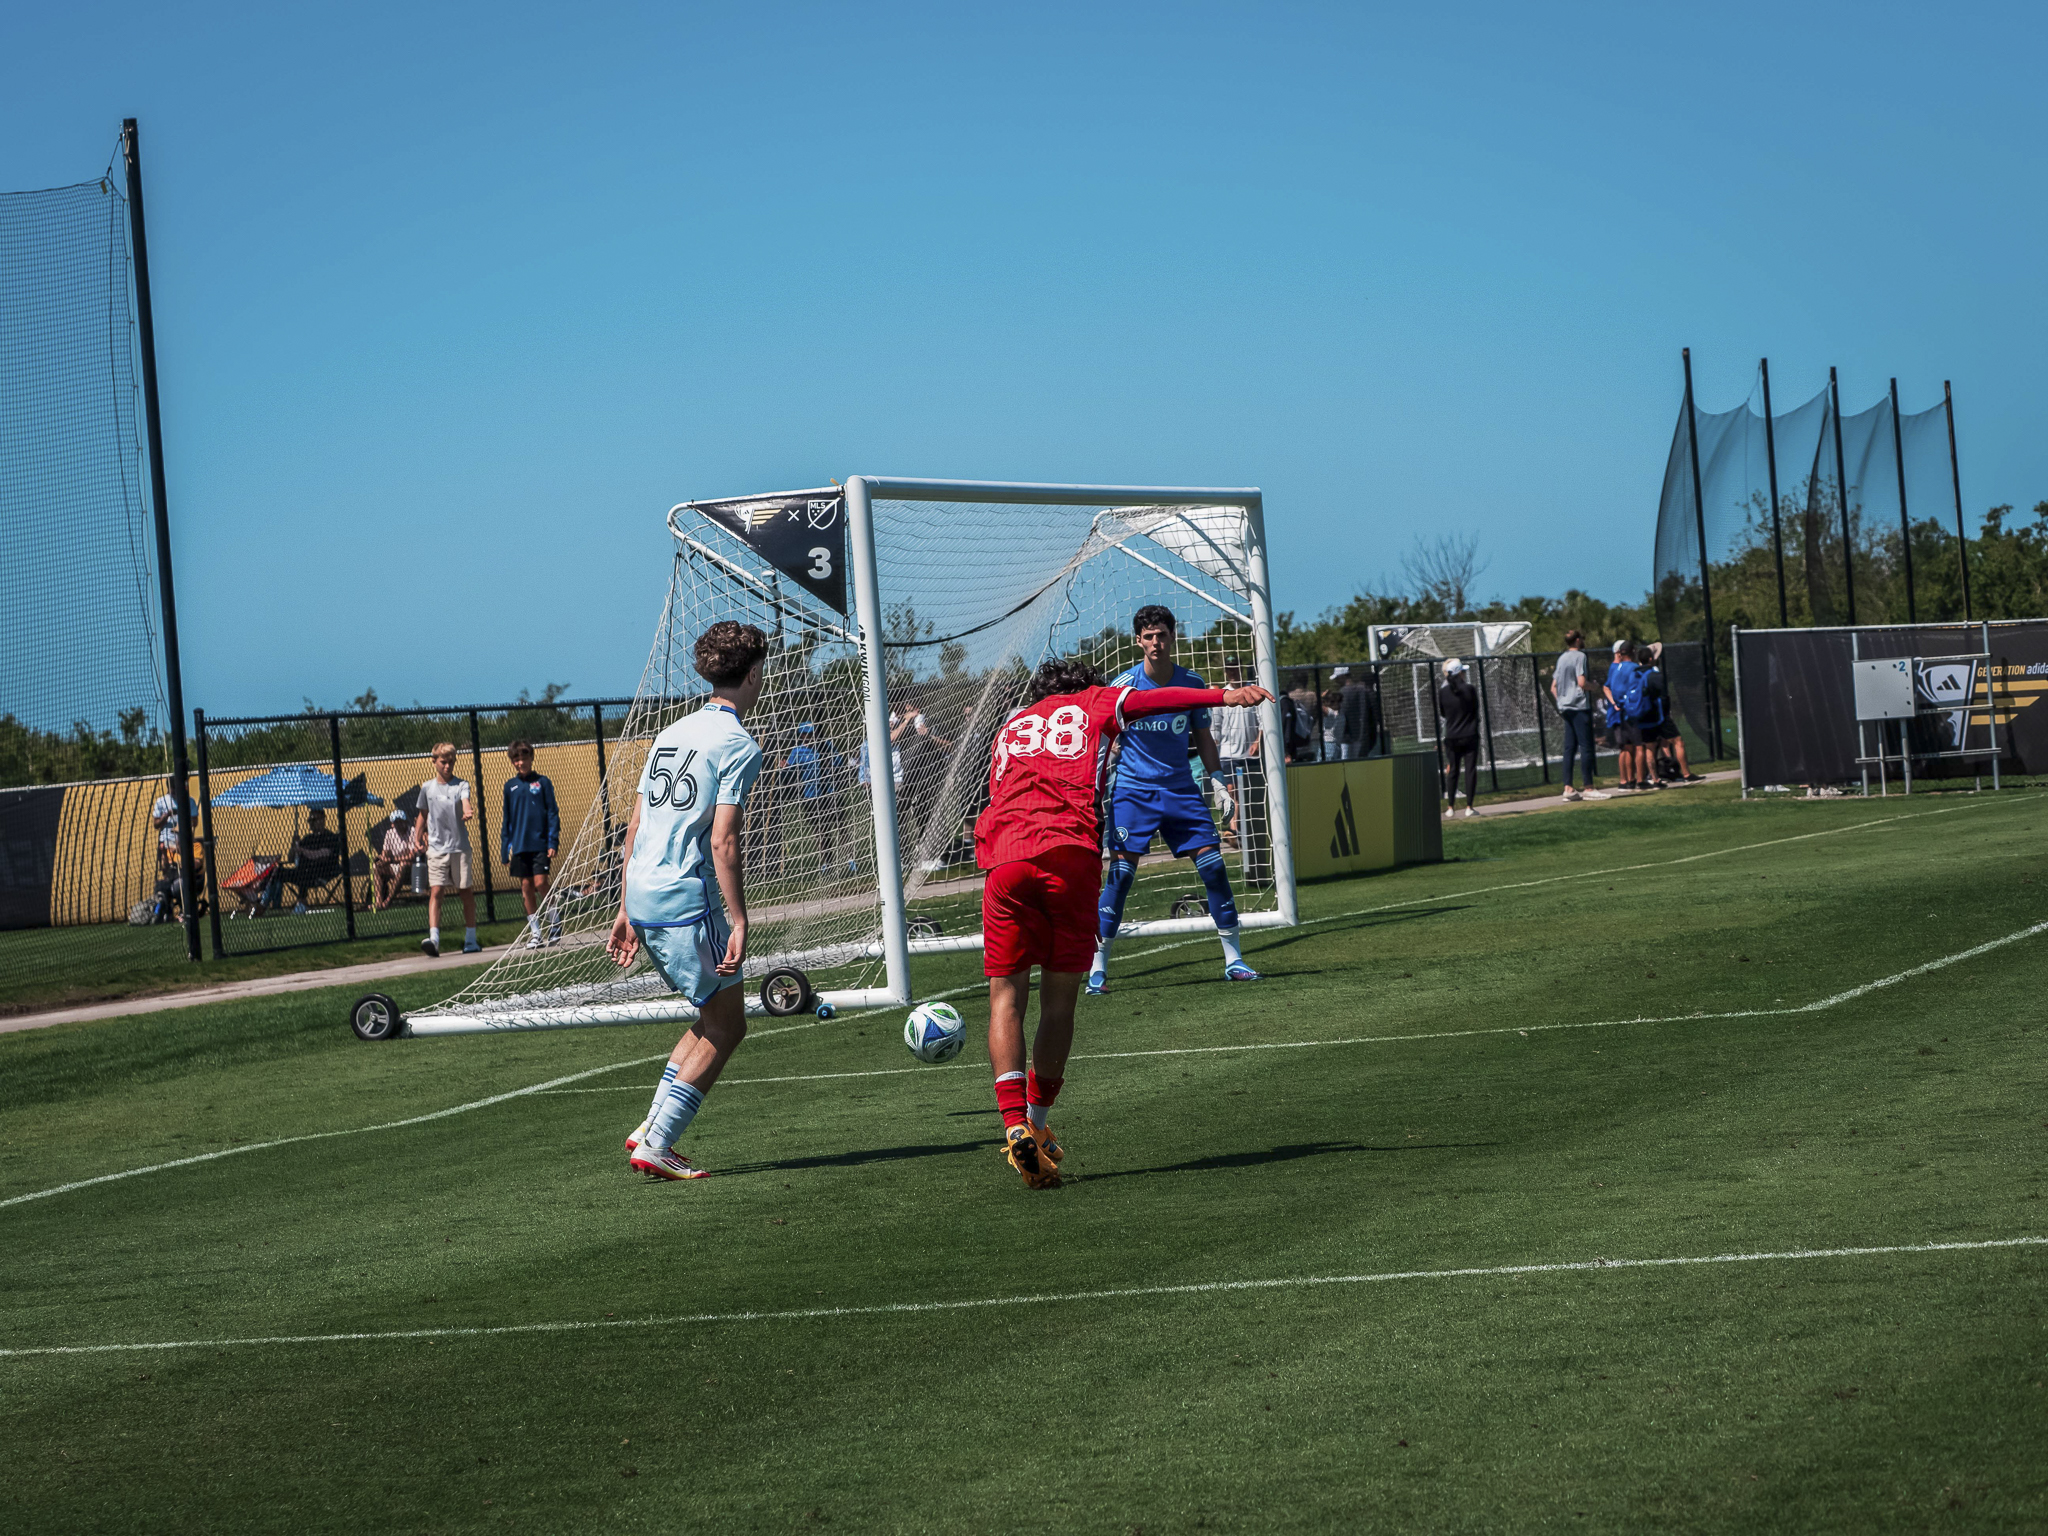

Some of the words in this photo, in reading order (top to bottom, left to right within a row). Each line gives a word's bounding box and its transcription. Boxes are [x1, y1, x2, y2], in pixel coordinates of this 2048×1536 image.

[807, 546, 832, 580] 3
[1898, 661, 1906, 672] 2
[1134, 720, 1168, 732] BMO
[648, 747, 698, 811] 56
